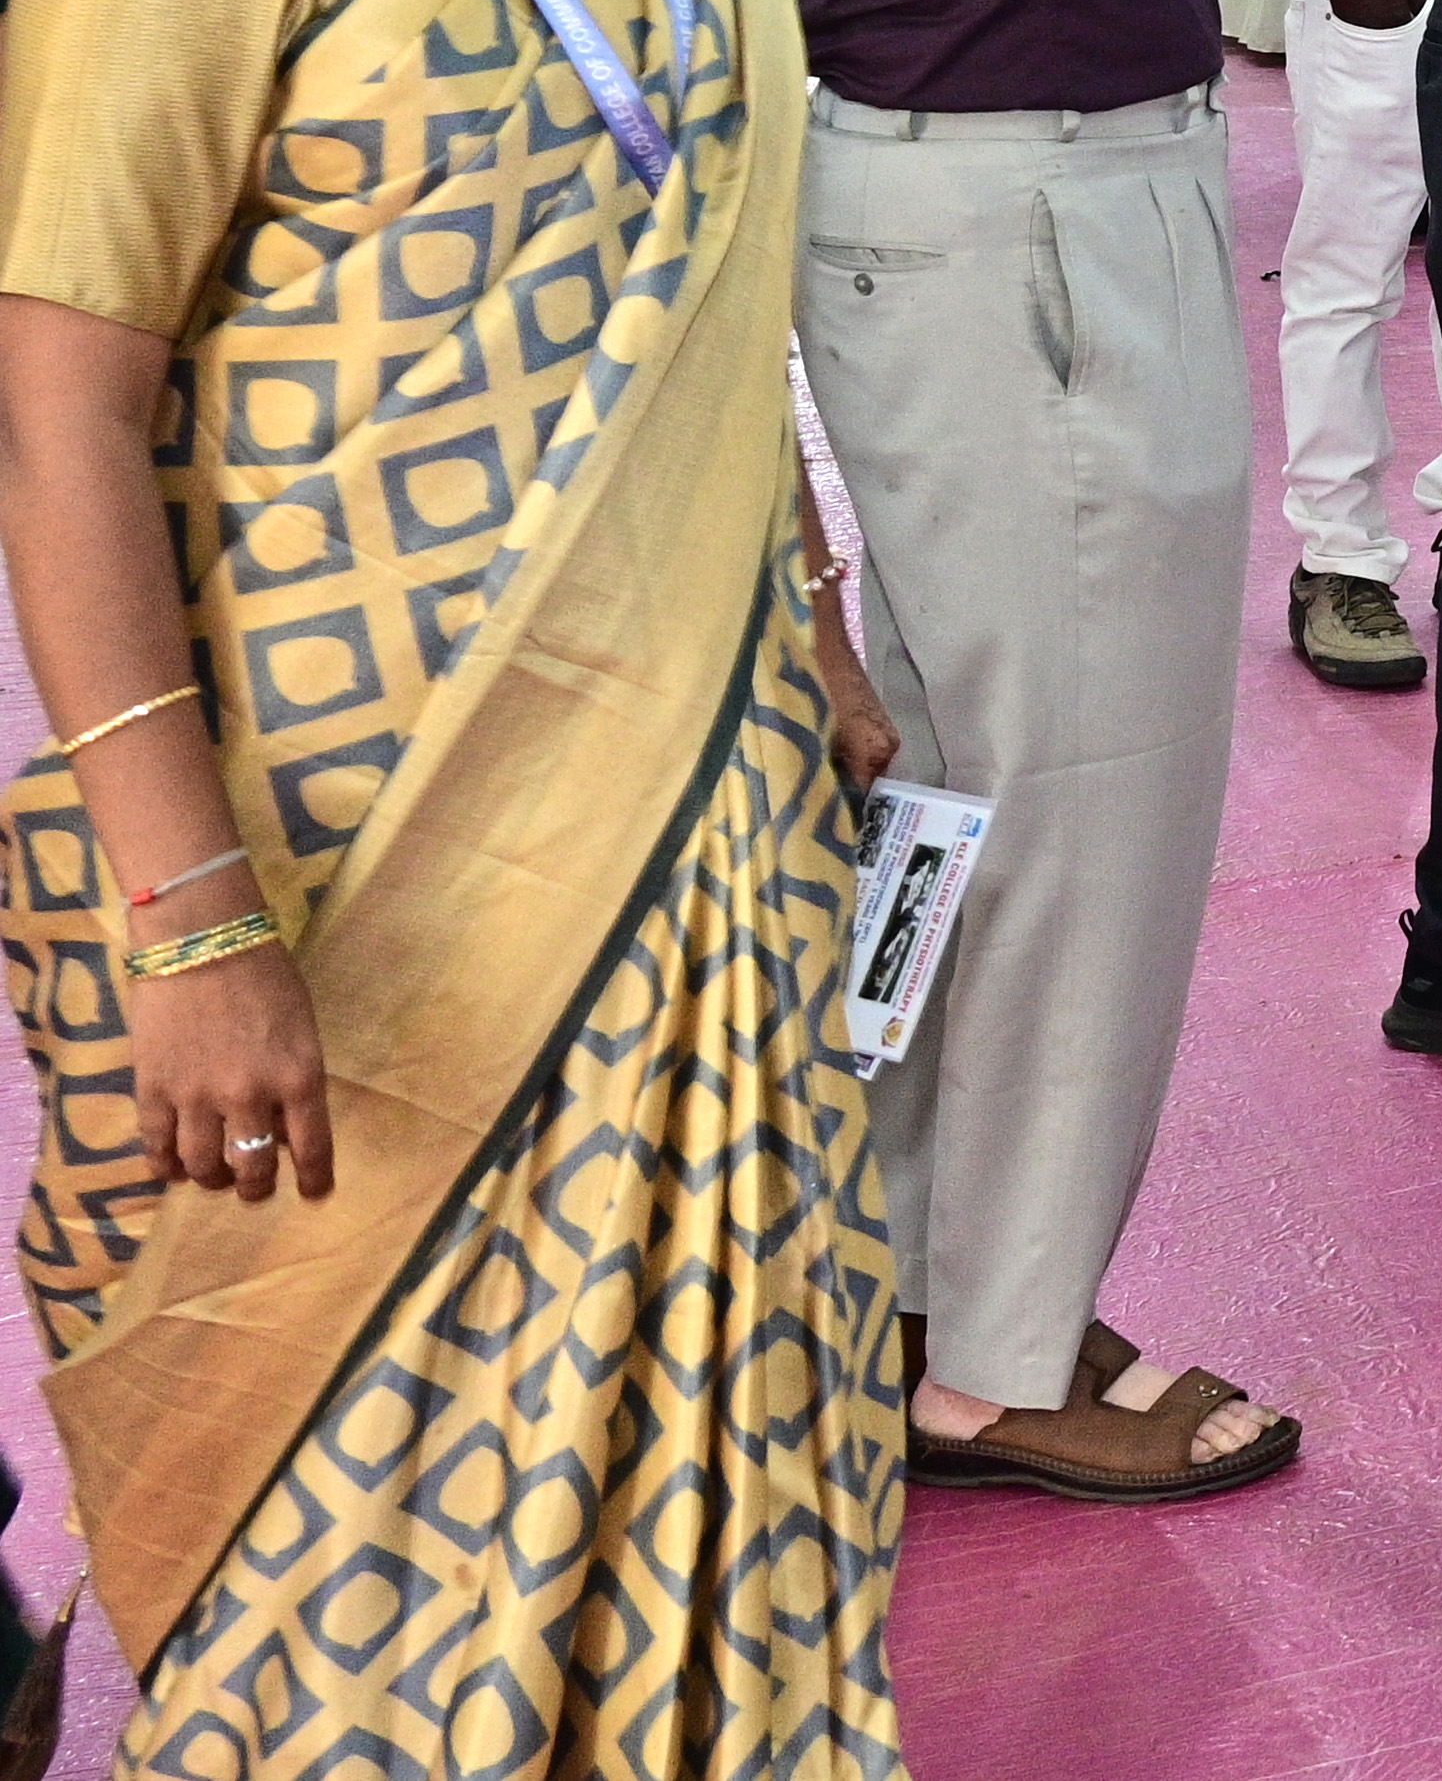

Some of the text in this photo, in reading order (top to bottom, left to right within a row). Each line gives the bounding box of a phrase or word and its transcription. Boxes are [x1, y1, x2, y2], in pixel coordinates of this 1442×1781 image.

[584, 58, 614, 83] OF
[602, 85, 655, 156] COLLEGE
[898, 841, 969, 1014] KLE COLLEGE OF PHYSIOTHERAPY
